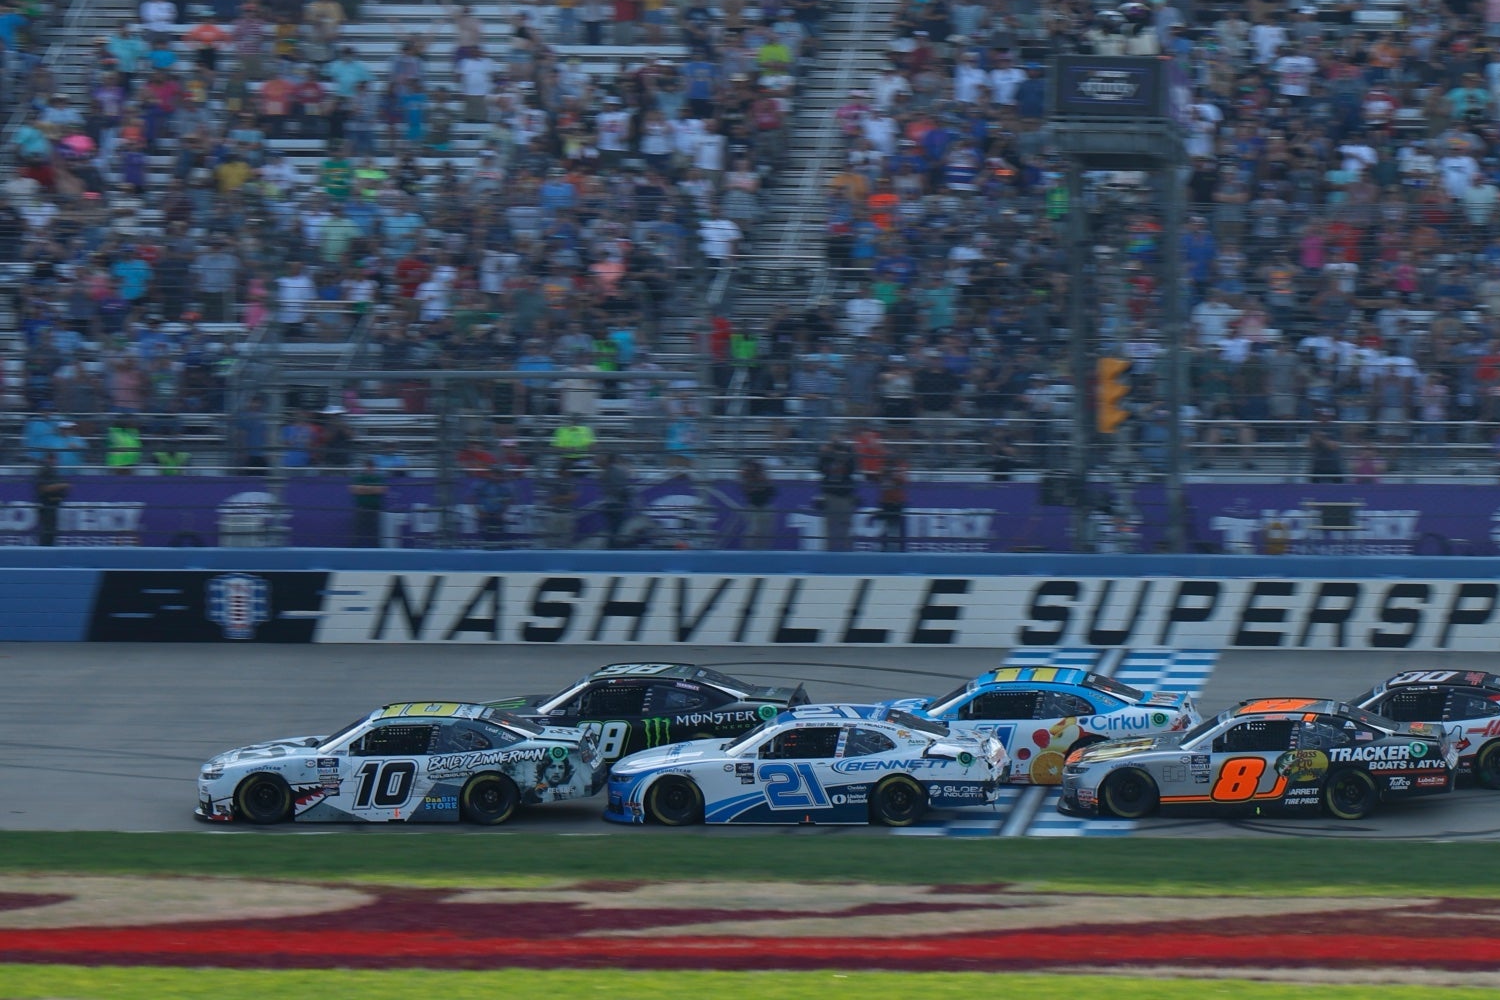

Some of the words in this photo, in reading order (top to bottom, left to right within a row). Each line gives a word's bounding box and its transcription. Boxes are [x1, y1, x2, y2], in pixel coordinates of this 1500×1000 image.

[369, 575, 974, 644] NASHVILLE
[1089, 712, 1149, 731] Cirkul
[428, 753, 469, 773] BAILEY
[465, 748, 546, 769] ZIMMERMAN
[1330, 746, 1410, 762] TRACKER
[1369, 761, 1408, 770] BOATS
[1417, 760, 1446, 769] ATVs
[846, 759, 949, 773] BENNETT
[353, 760, 419, 810] 10
[758, 762, 834, 811] 21
[1211, 757, 1267, 802] 8
[425, 802, 458, 810] STORE
